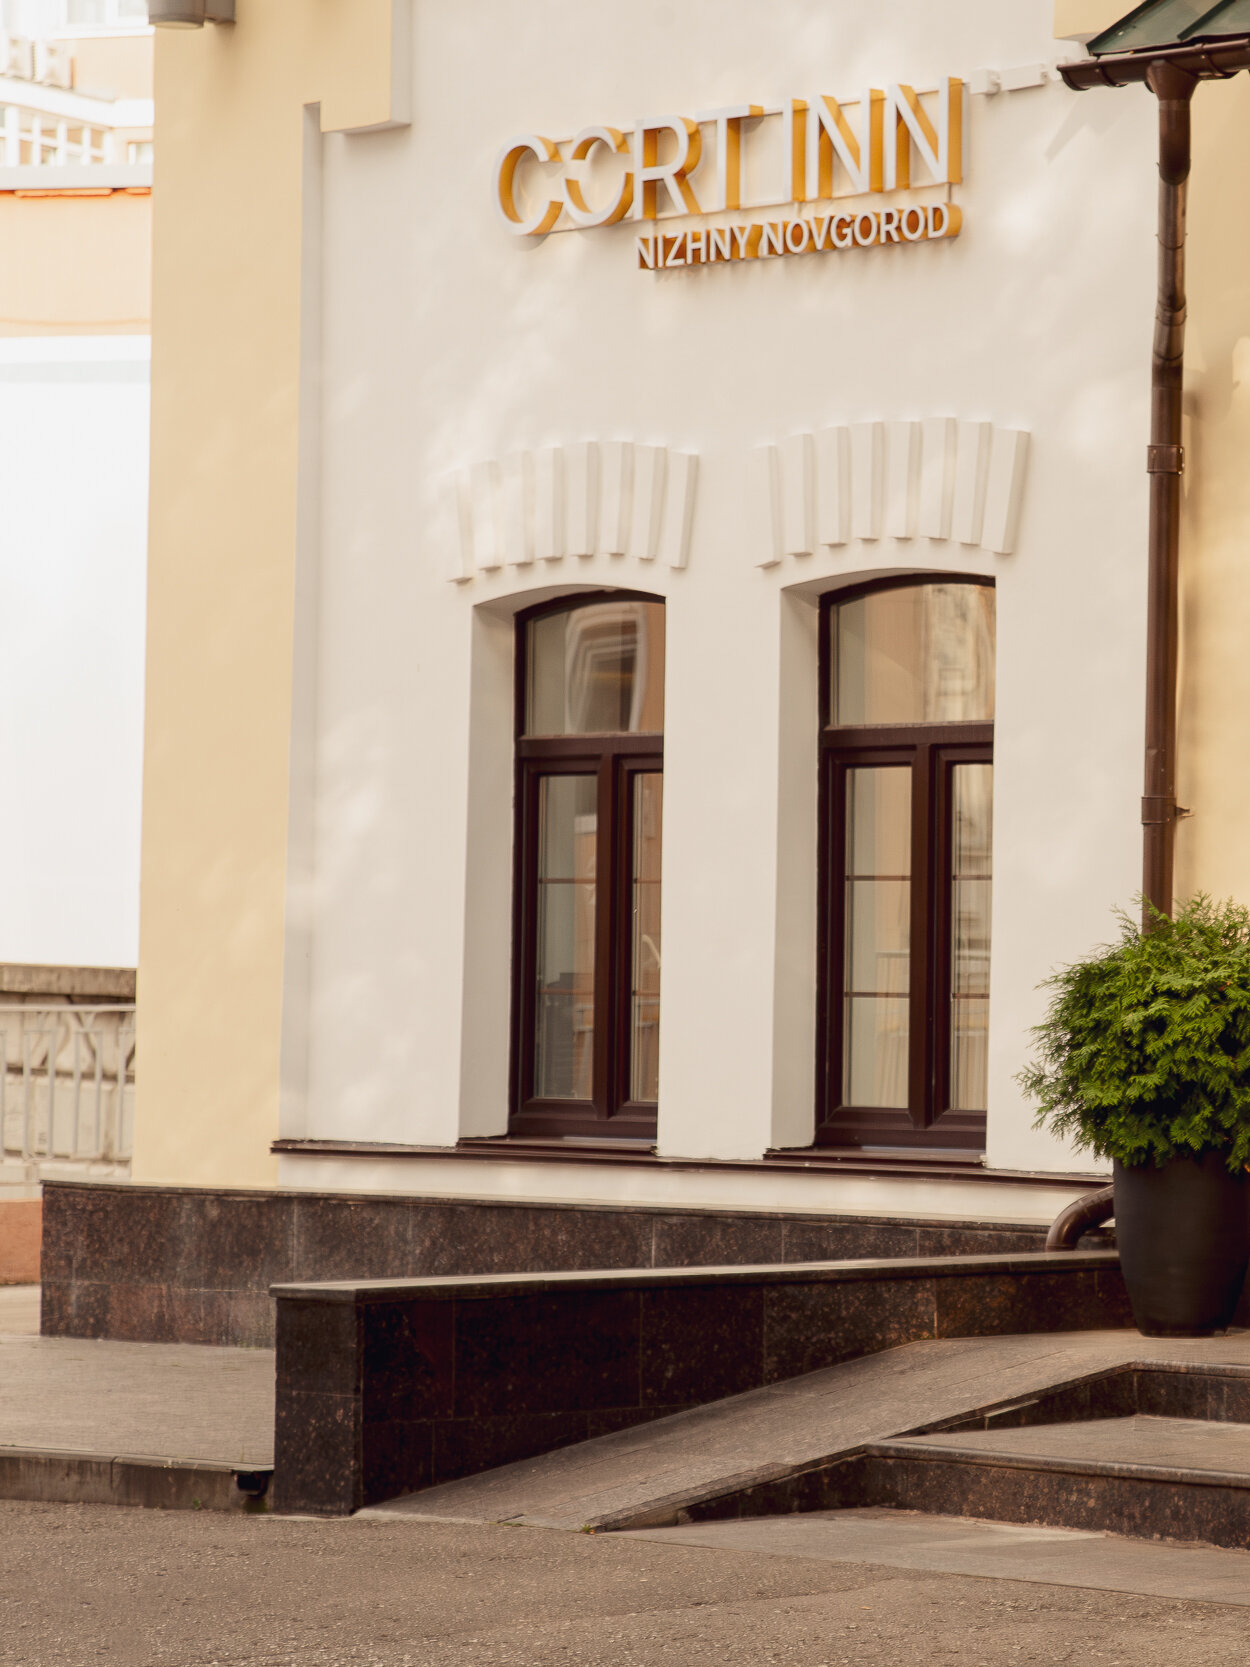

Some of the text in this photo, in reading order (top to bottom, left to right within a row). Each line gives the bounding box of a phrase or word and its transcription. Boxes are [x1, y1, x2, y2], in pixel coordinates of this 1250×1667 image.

[784, 77, 962, 203] INN
[634, 203, 962, 270] NIZHNY NOVGOROD
